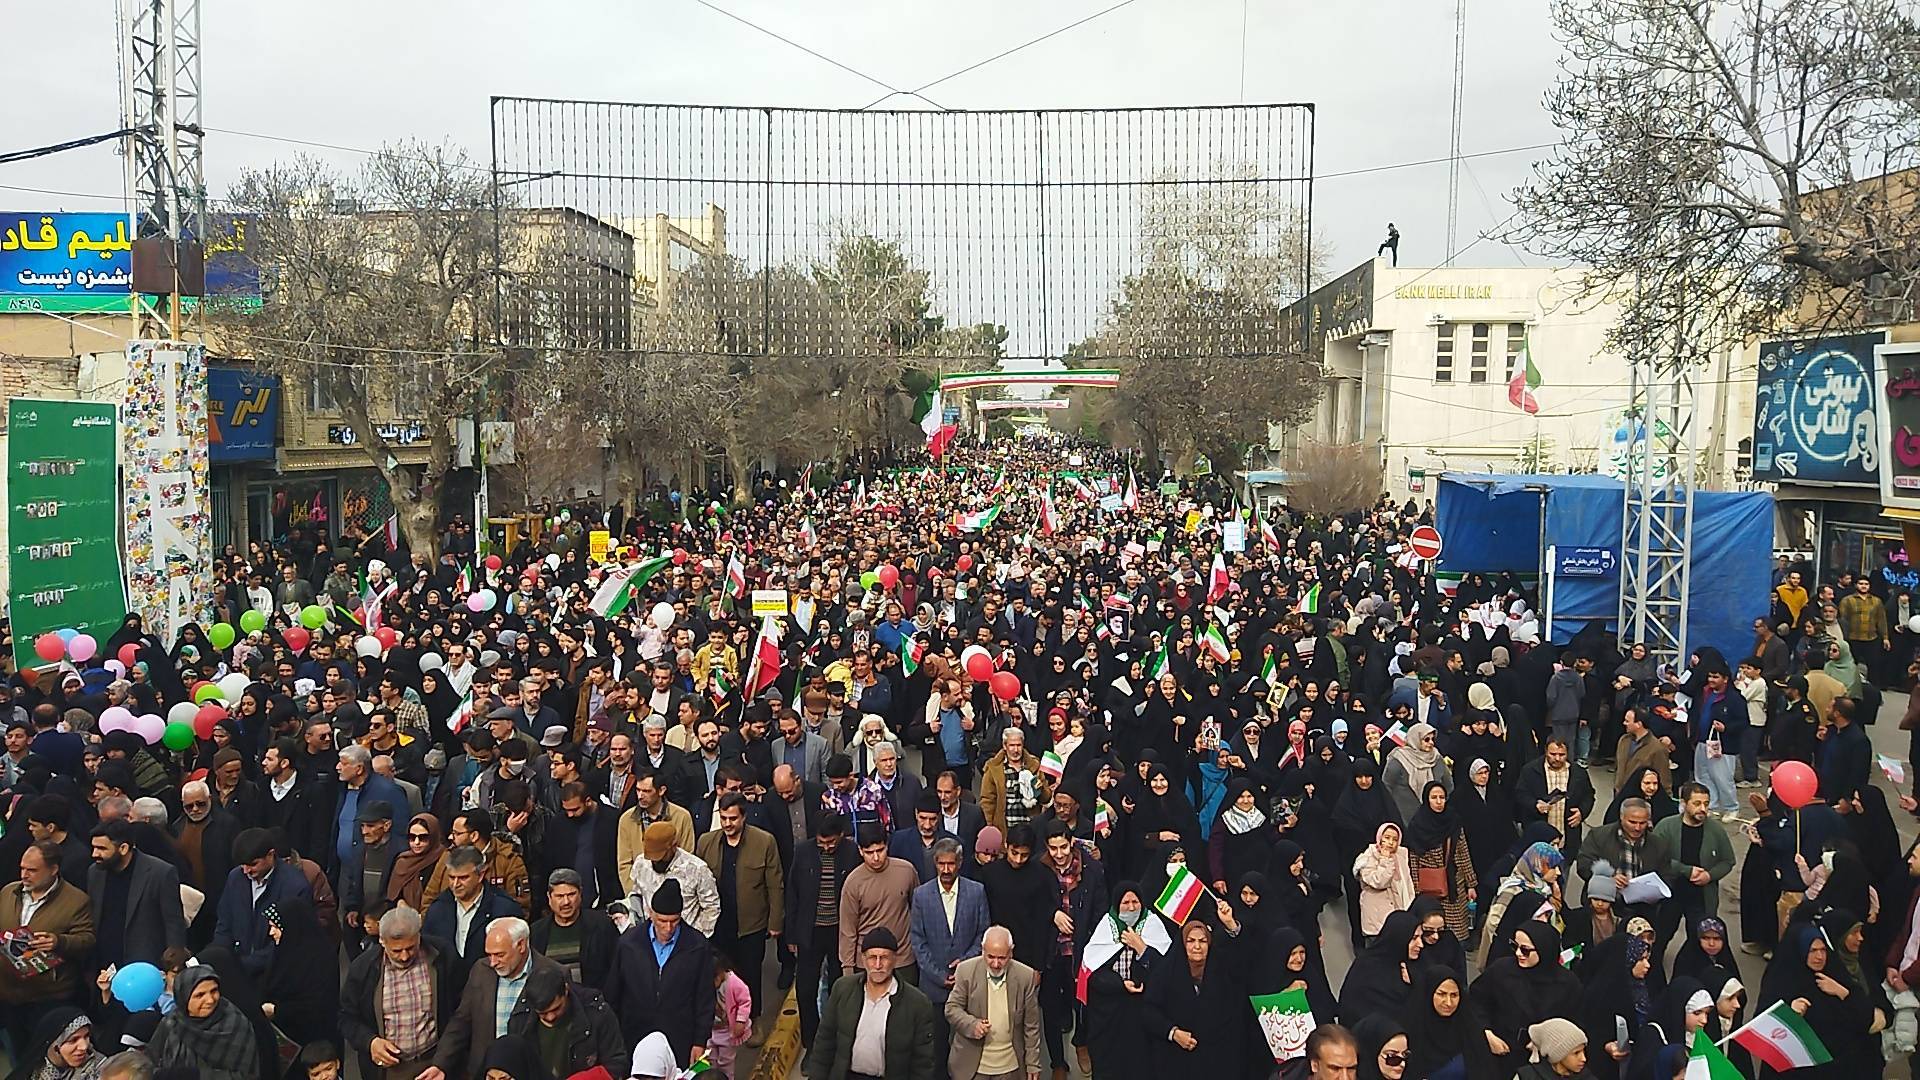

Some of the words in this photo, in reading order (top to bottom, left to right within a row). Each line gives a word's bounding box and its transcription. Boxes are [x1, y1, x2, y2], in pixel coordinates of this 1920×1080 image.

[0, 217, 58, 251] قاد
[68, 220, 132, 259] لیم
[18, 268, 72, 290] نیست
[1395, 285, 1425, 299] BANK
[1428, 285, 1461, 299] MELLI
[1464, 284, 1492, 299] IRAN
[1804, 367, 1862, 408] بیوتی
[1800, 402, 1851, 447] شاپ
